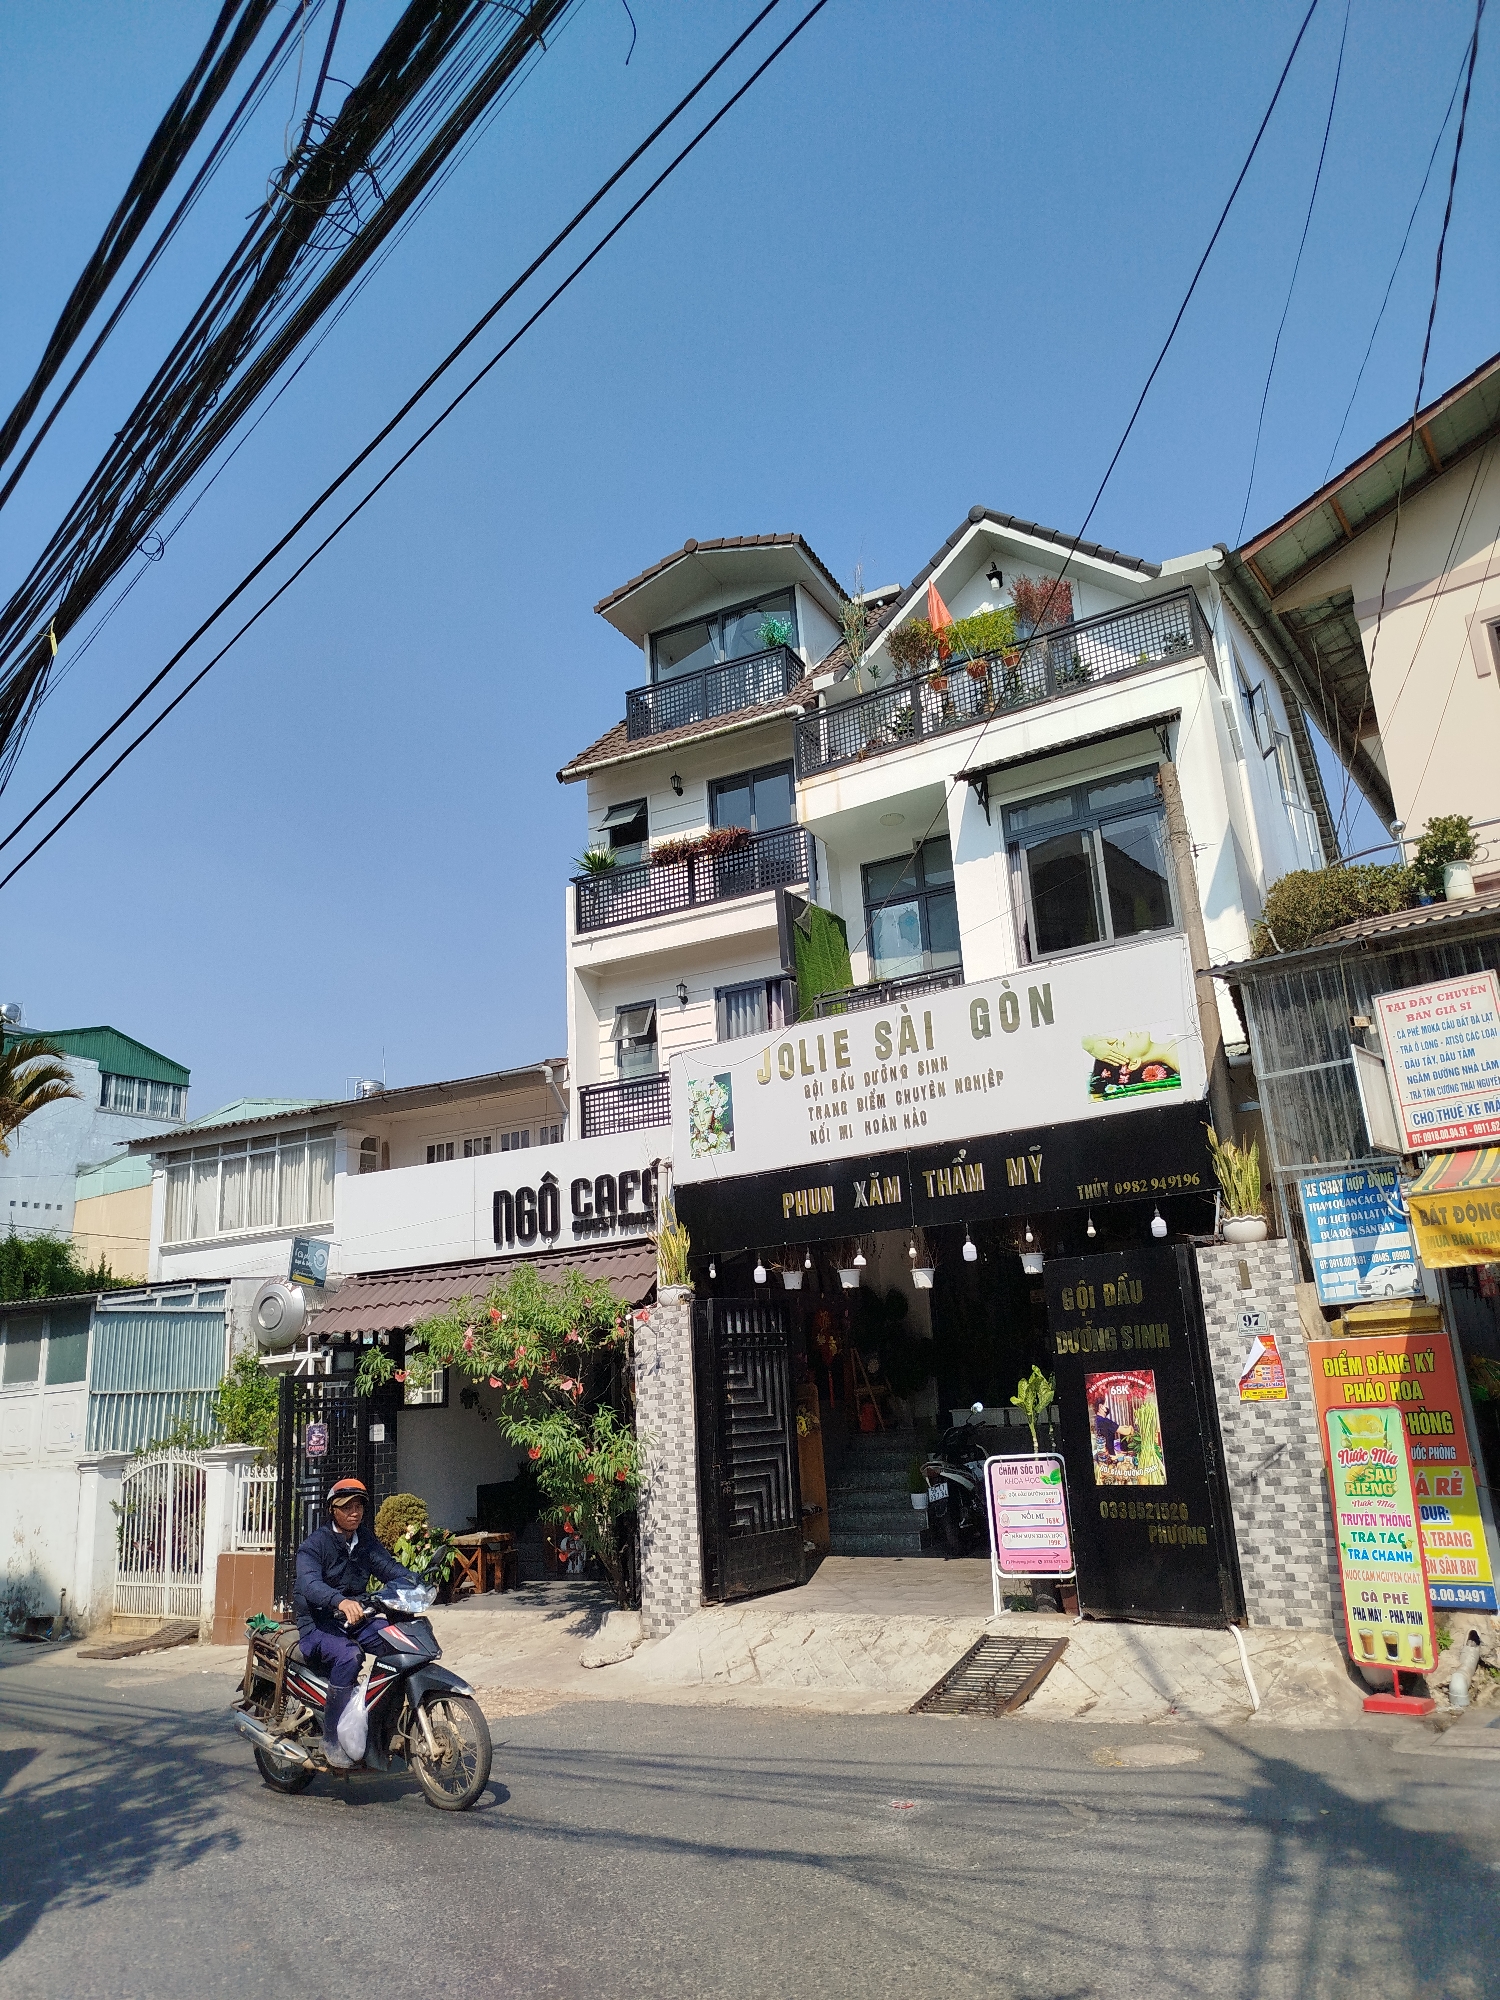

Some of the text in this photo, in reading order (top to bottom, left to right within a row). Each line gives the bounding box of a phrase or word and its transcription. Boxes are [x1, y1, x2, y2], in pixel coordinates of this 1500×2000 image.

[1386, 984, 1487, 1013] TẠI ĐÂY CHUYÊN
[1406, 1009, 1432, 1022] BÁN
[1435, 1003, 1457, 1016] GIÁ
[756, 979, 1055, 1085] JOLIE SÀI GÒN
[1396, 1028, 1406, 1039] CÀ
[1407, 1025, 1420, 1037] PHÊ
[1421, 1022, 1440, 1035] MOKA
[1481, 1012, 1494, 1024] LẠT
[1421, 1039, 1438, 1051] LONG
[1481, 1028, 1498, 1040] LOẠI
[804, 1078, 824, 1100] GỘI
[863, 1062, 908, 1088] DƯỠNG
[917, 1056, 949, 1077] SINH
[807, 1067, 1004, 1122] TRANG ĐIỂM CHUYÊN NGHIỆP
[1413, 1111, 1434, 1125] CHO
[1436, 1104, 1464, 1121] THUÊ
[1467, 1103, 1481, 1116] XE
[809, 1109, 928, 1145] NỐI MI HOÀN HẢO
[782, 1145, 1043, 1219] PHUN XĂM THẨM MỸ
[1077, 1172, 1200, 1200] THỦY 0982 949196
[1304, 1183, 1318, 1198] XE
[1320, 1179, 1344, 1196] CHẠY
[1346, 1175, 1365, 1193] HỢP
[1308, 1200, 1332, 1212] THAM
[1333, 1197, 1358, 1210] QUAN
[1364, 1208, 1380, 1221] LẠT
[1419, 1200, 1500, 1228] BẤT ĐỘNG
[1377, 1222, 1395, 1233] BAY
[1450, 1231, 1474, 1246] BÁN
[1061, 1272, 1143, 1317] GỘI ĐẦU
[1242, 1313, 1260, 1327] 97
[1055, 1320, 1171, 1355] DƯỠNG SINH
[1322, 1348, 1435, 1377] ĐIỂM ĐĂNG KÝ
[1110, 1384, 1130, 1395] 68K
[1343, 1378, 1425, 1403] PHÁO HOA
[1337, 1447, 1399, 1466] Nước Mía
[1428, 1442, 1456, 1460] PHÒNG
[998, 1464, 1045, 1476] CHĂM SÓC DA
[1004, 1476, 1041, 1485] KHOA HỌC
[1436, 1470, 1463, 1496] RẺ
[1100, 1500, 1189, 1520] 0338521526
[1352, 1499, 1396, 1509] Nước Mía
[1419, 1505, 1450, 1521] OUR:
[1341, 1508, 1412, 1528] TRUYỀN THỐNG
[1148, 1524, 1208, 1549] PHƯỢNG
[1350, 1531, 1376, 1543] TRÀ
[1430, 1531, 1472, 1547] TRANG
[1347, 1548, 1413, 1562] TRÀ CHANH
[1362, 1569, 1375, 1582] CAM
[1440, 1556, 1458, 1575] SÂN
[1460, 1559, 1477, 1576] BAY
[1361, 1589, 1410, 1605] CÀ PHÊ
[1352, 1606, 1423, 1625] PHA MÁY PHA PHIN
[376, 1661, 398, 1673] HONDA
